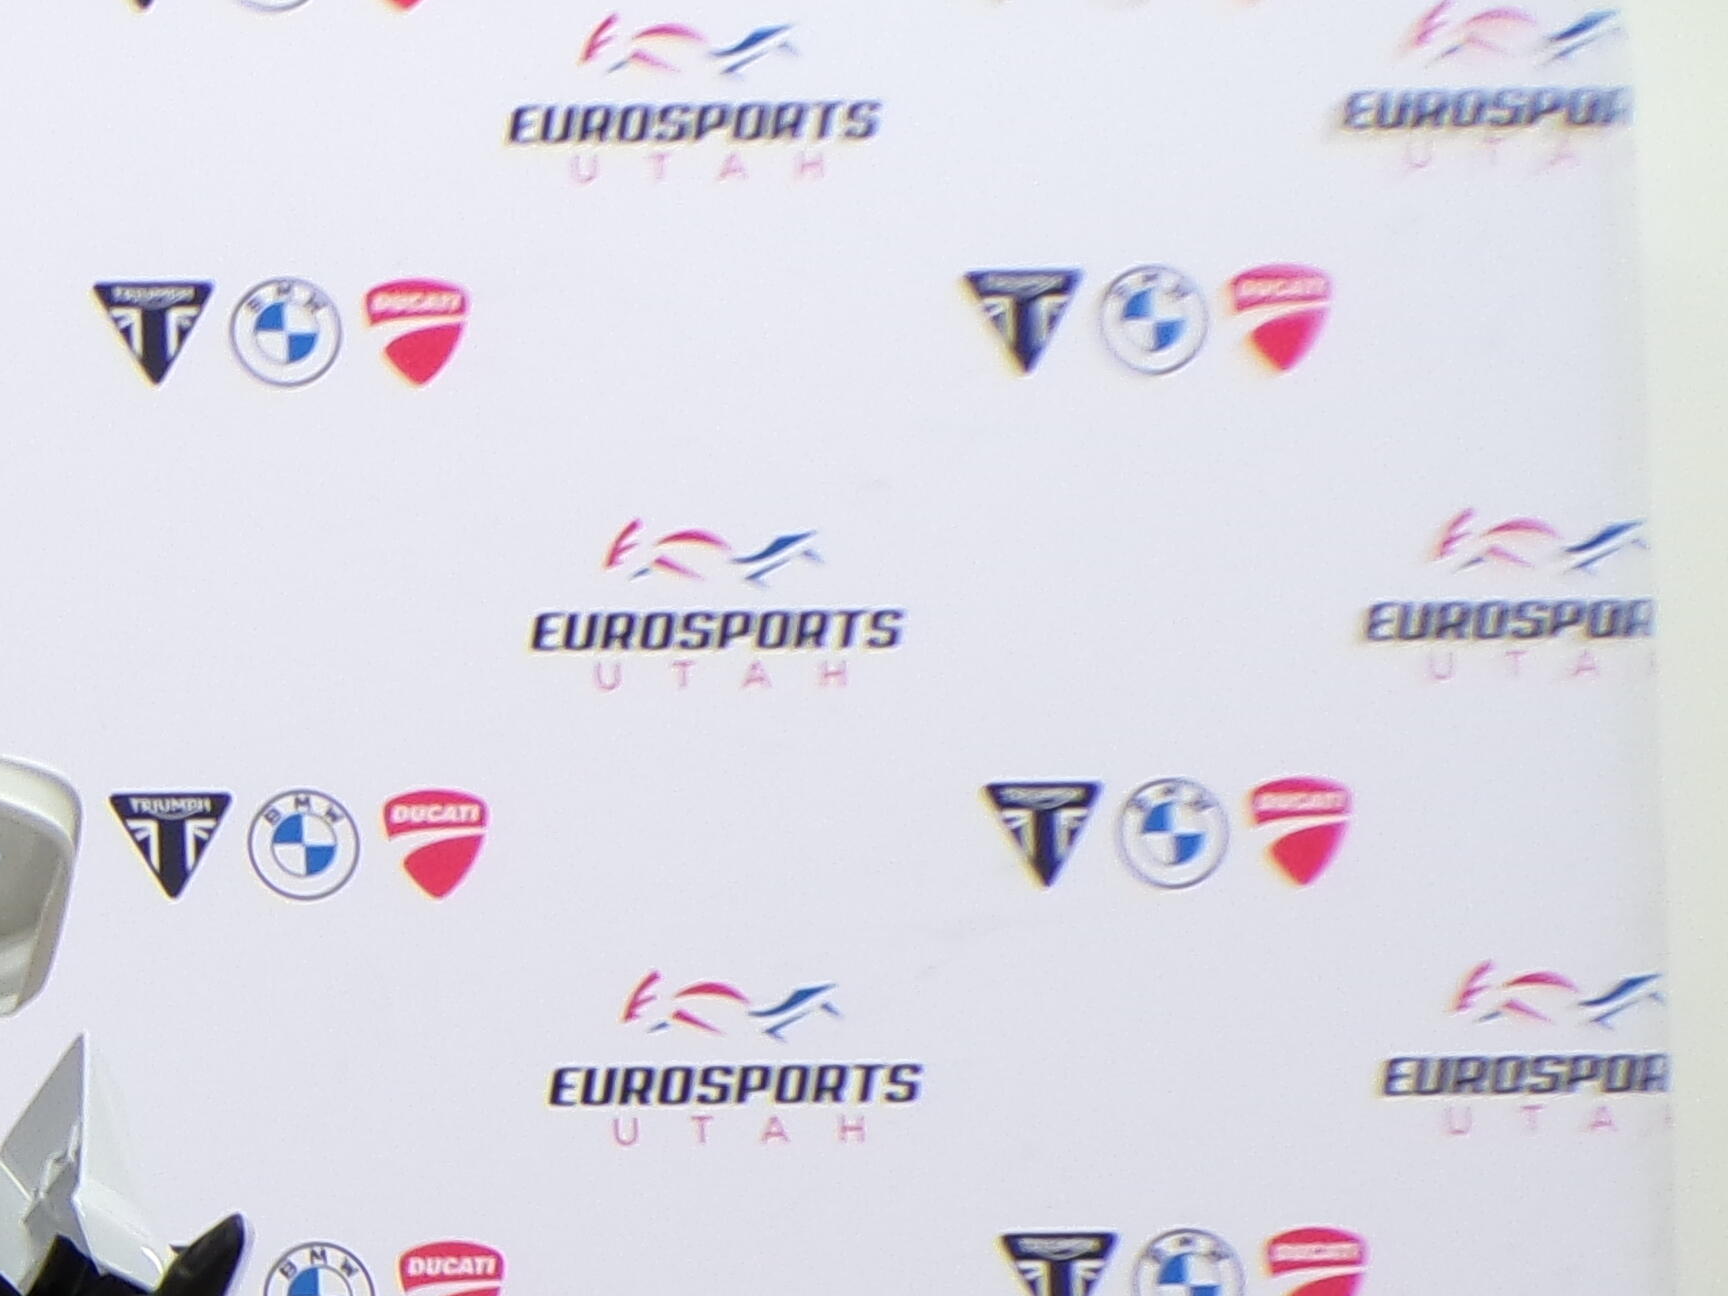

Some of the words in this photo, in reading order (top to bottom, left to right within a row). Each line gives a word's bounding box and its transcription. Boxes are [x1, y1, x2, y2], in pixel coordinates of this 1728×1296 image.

[508, 102, 879, 143] EUROSPORTS
[572, 152, 825, 185] UTAH
[531, 610, 902, 650] EUROSPORTS
[592, 659, 848, 692] UTAH
[1426, 650, 1657, 682] UTA
[131, 797, 212, 814] TRIUMPH
[392, 803, 479, 823] DUCATI
[549, 1064, 921, 1106] EUROSPORTS
[612, 1115, 866, 1147] UTAH
[1445, 1104, 1672, 1136] UTA
[407, 1256, 498, 1277] DUCATI
